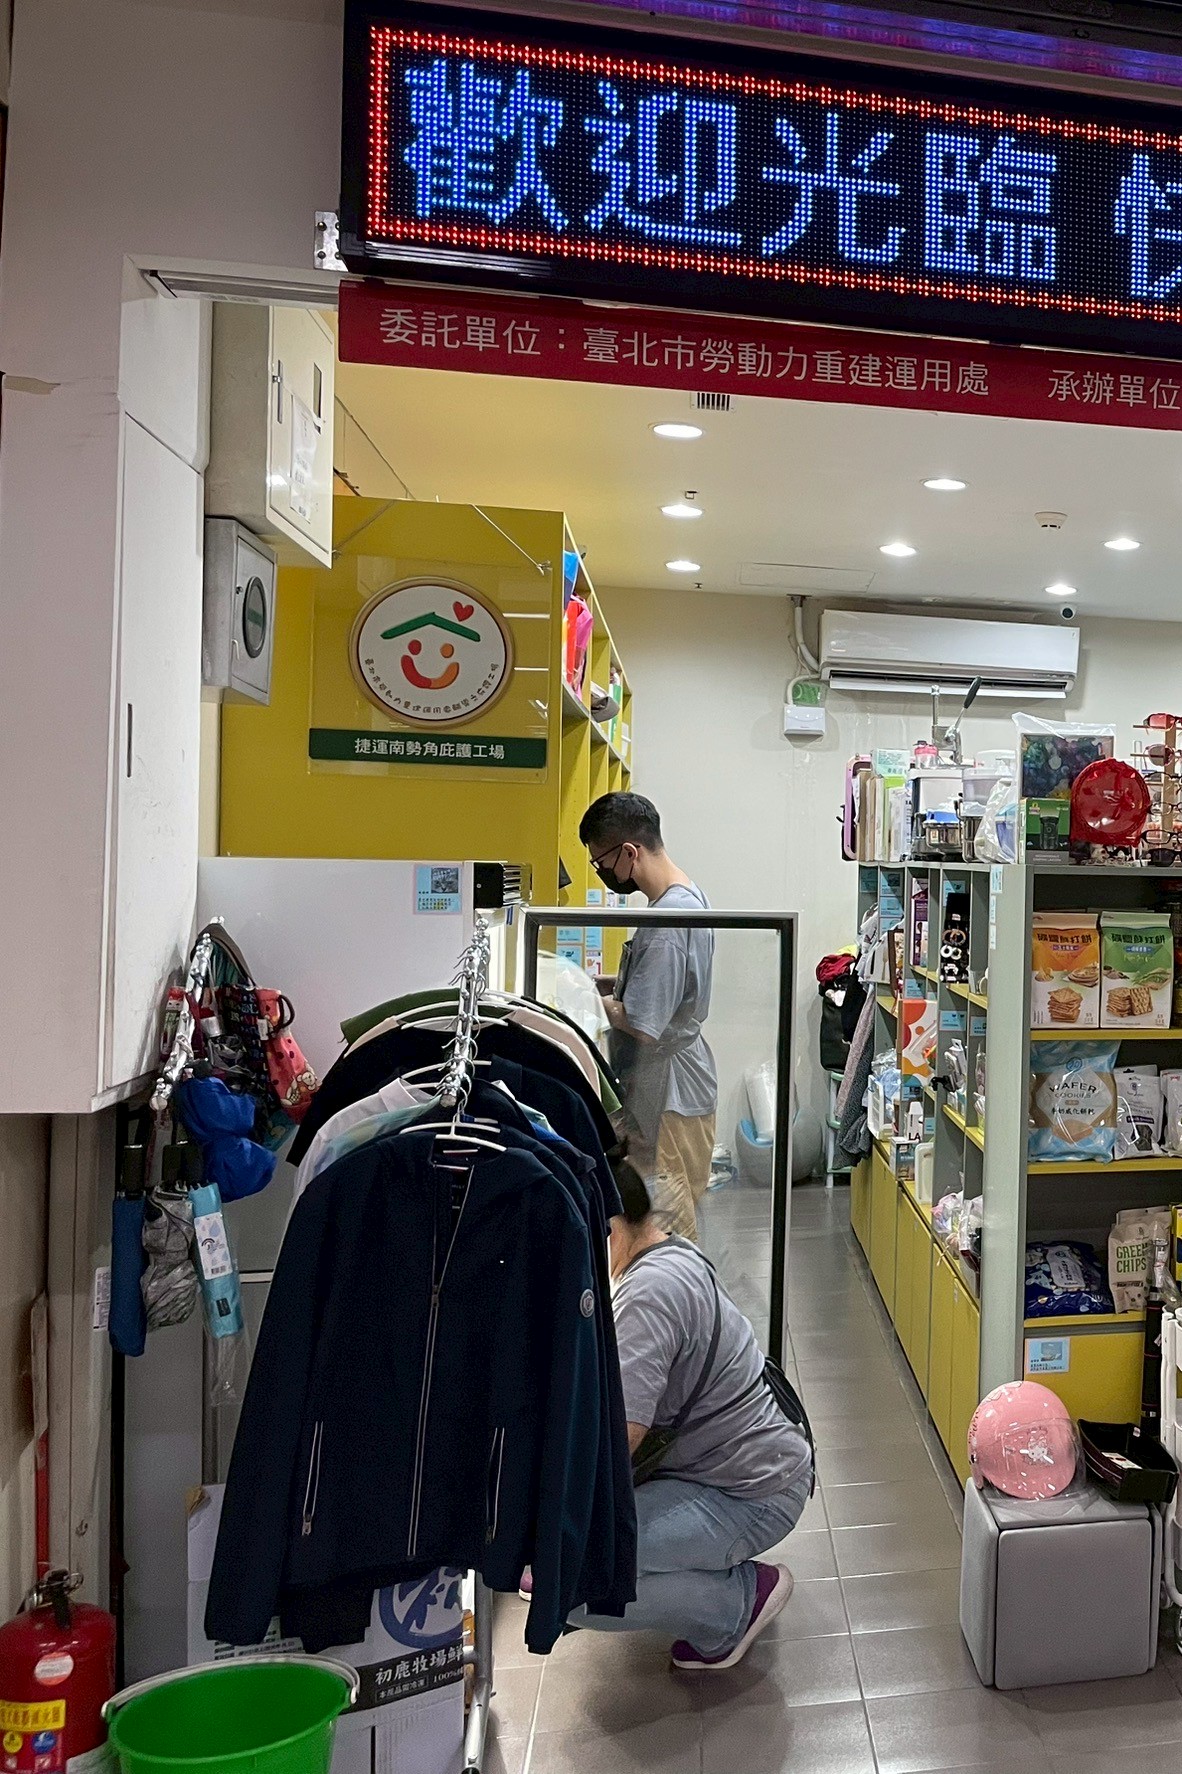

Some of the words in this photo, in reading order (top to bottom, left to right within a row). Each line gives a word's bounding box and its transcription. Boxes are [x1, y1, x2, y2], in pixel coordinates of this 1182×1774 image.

[403, 58, 1057, 283] 歡迎光臨
[379, 307, 989, 397] 委託單位：臺北市勞動力重建運用處
[354, 737, 506, 760] 捷運南勢角庇護工場
[1049, 1081, 1097, 1094] WAFER
[1116, 1243, 1149, 1259] GREEN
[1116, 1257, 1147, 1273] CHIPS
